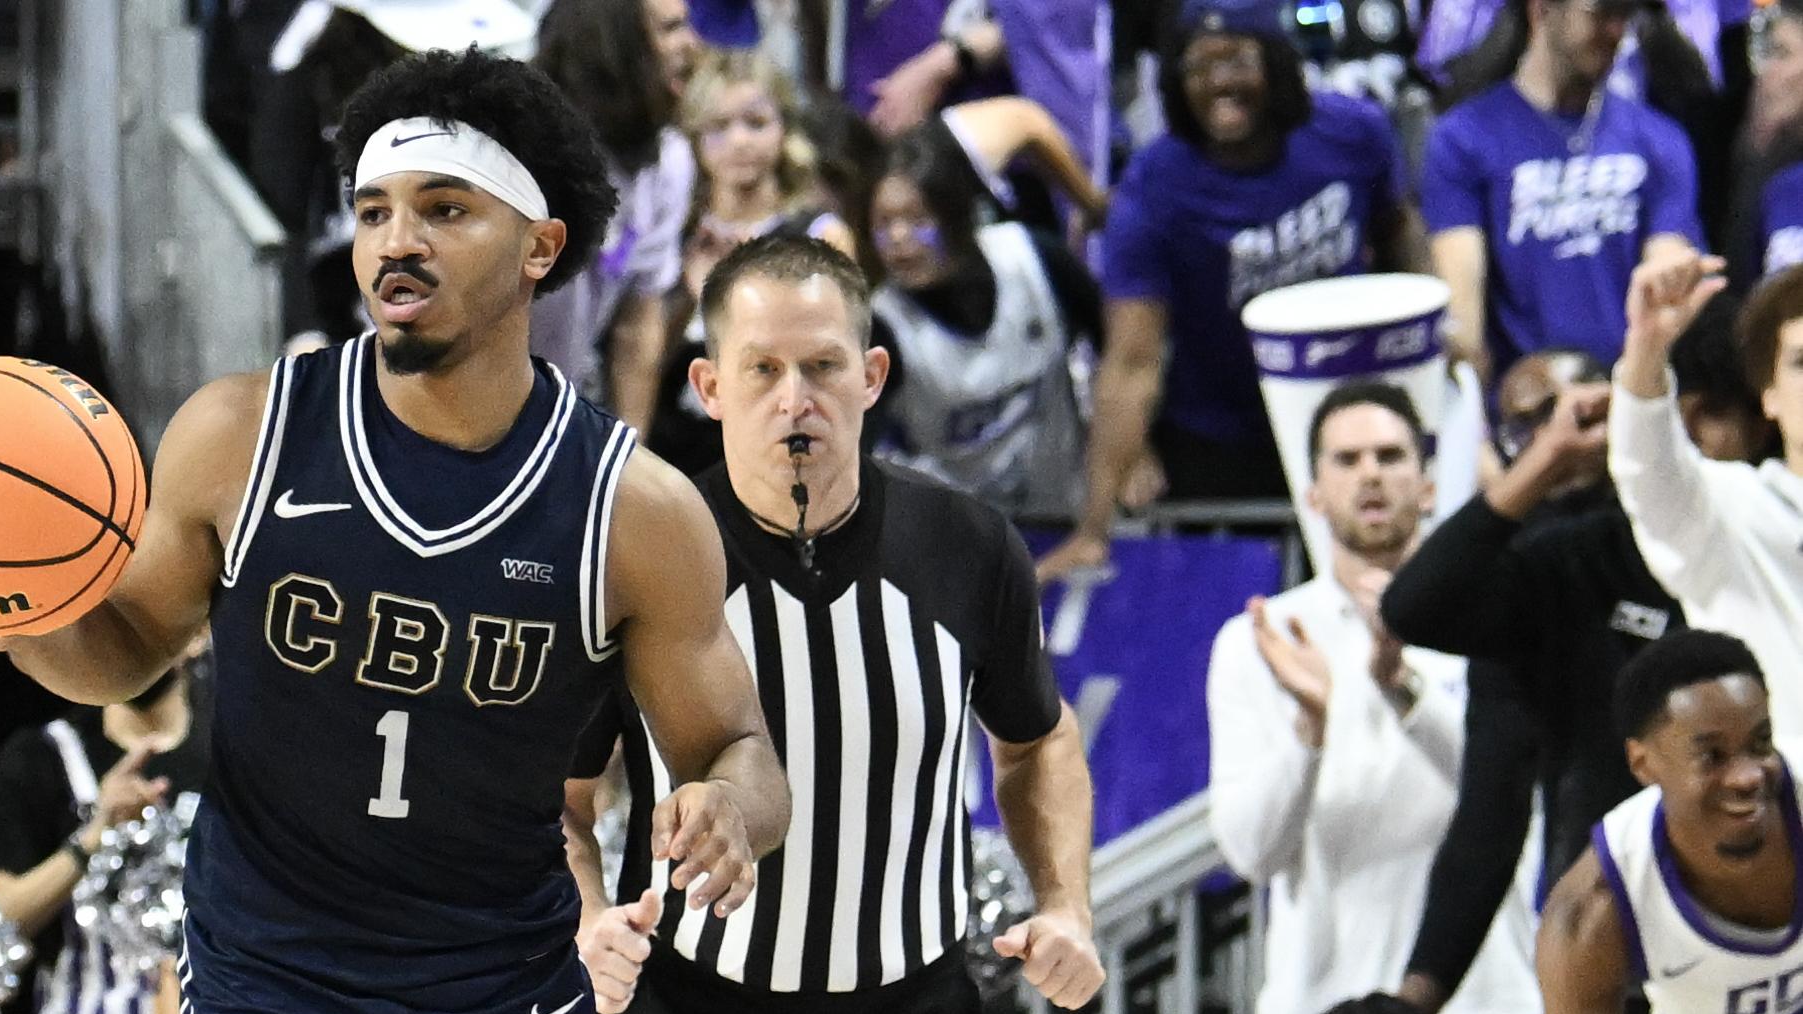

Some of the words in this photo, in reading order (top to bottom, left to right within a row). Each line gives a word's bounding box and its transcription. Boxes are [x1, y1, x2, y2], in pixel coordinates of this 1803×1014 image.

[500, 558, 554, 584] WAC
[264, 572, 556, 707] CBU
[367, 709, 409, 819] 1
